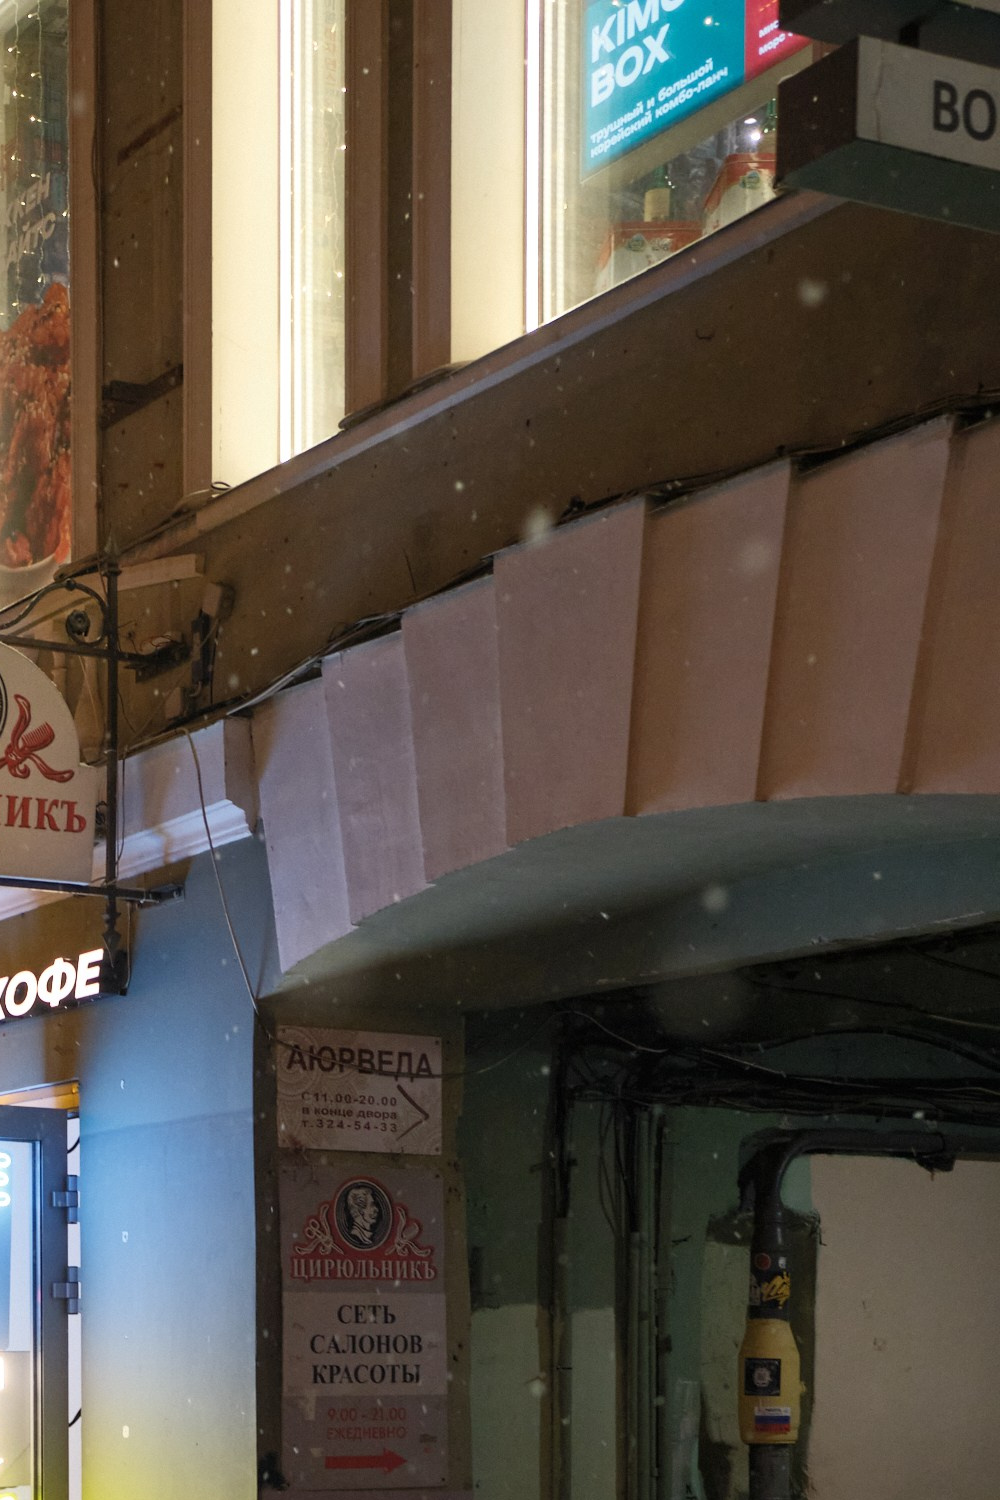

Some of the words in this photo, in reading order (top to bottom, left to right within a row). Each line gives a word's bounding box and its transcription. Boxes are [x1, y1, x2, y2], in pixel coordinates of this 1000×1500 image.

[591, 23, 671, 108] BOX
[658, 57, 713, 101] большой
[655, 67, 728, 118] комбо-ланч
[286, 1044, 434, 1081] АЮРВЕДА
[314, 1107, 354, 1118] конце
[356, 1109, 397, 1121] двора
[291, 1258, 436, 1281] ЦИРЮЛЬНИКЪ
[337, 1304, 396, 1325] СЕТЬ
[310, 1334, 423, 1354] САЛОНОВ
[312, 1363, 421, 1384] КРАСОТЫ
[327, 1425, 407, 1442] ЕЖЕДНЕВНО
